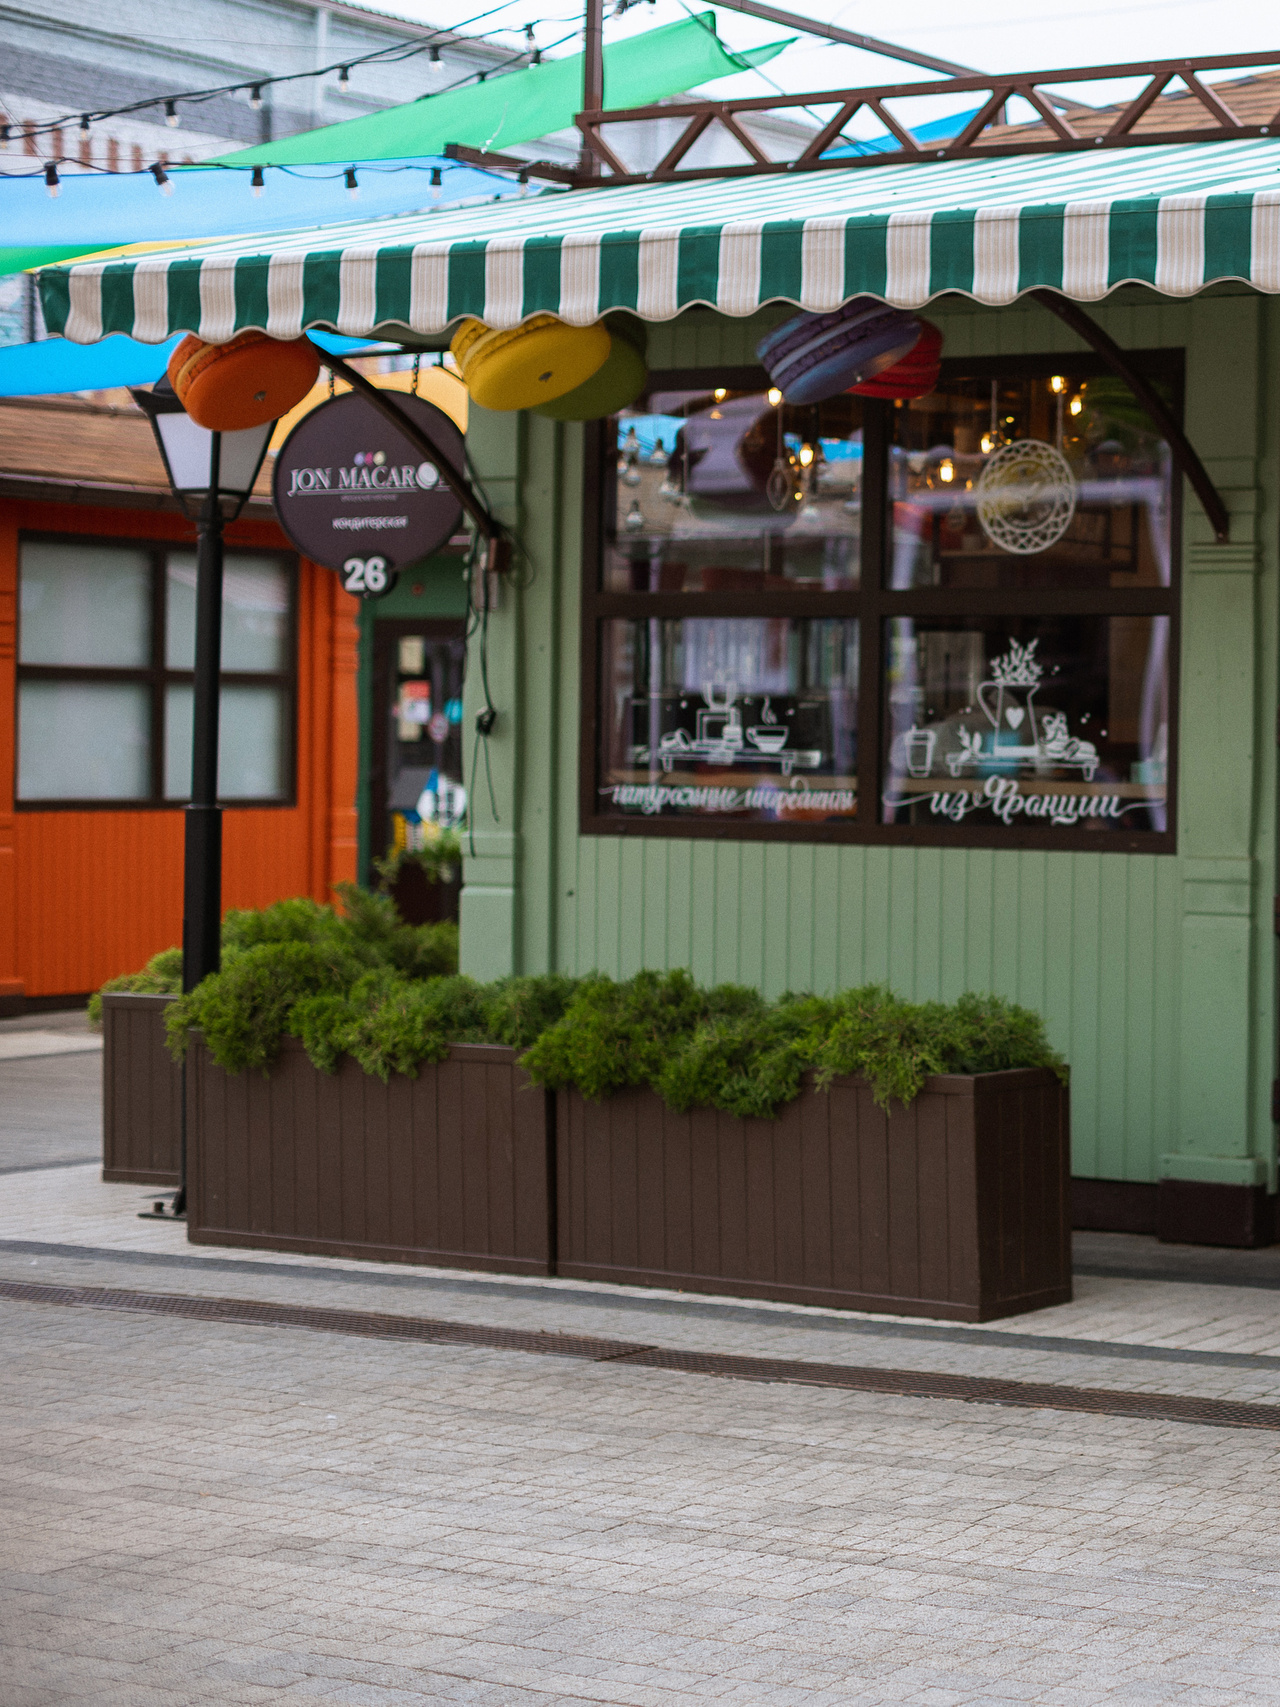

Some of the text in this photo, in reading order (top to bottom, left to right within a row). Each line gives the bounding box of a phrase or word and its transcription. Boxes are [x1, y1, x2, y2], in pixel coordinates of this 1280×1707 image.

[287, 461, 448, 498] JON MACARO
[331, 516, 409, 531] кондитерская
[343, 556, 387, 592] 26
[980, 774, 1124, 825] Франции
